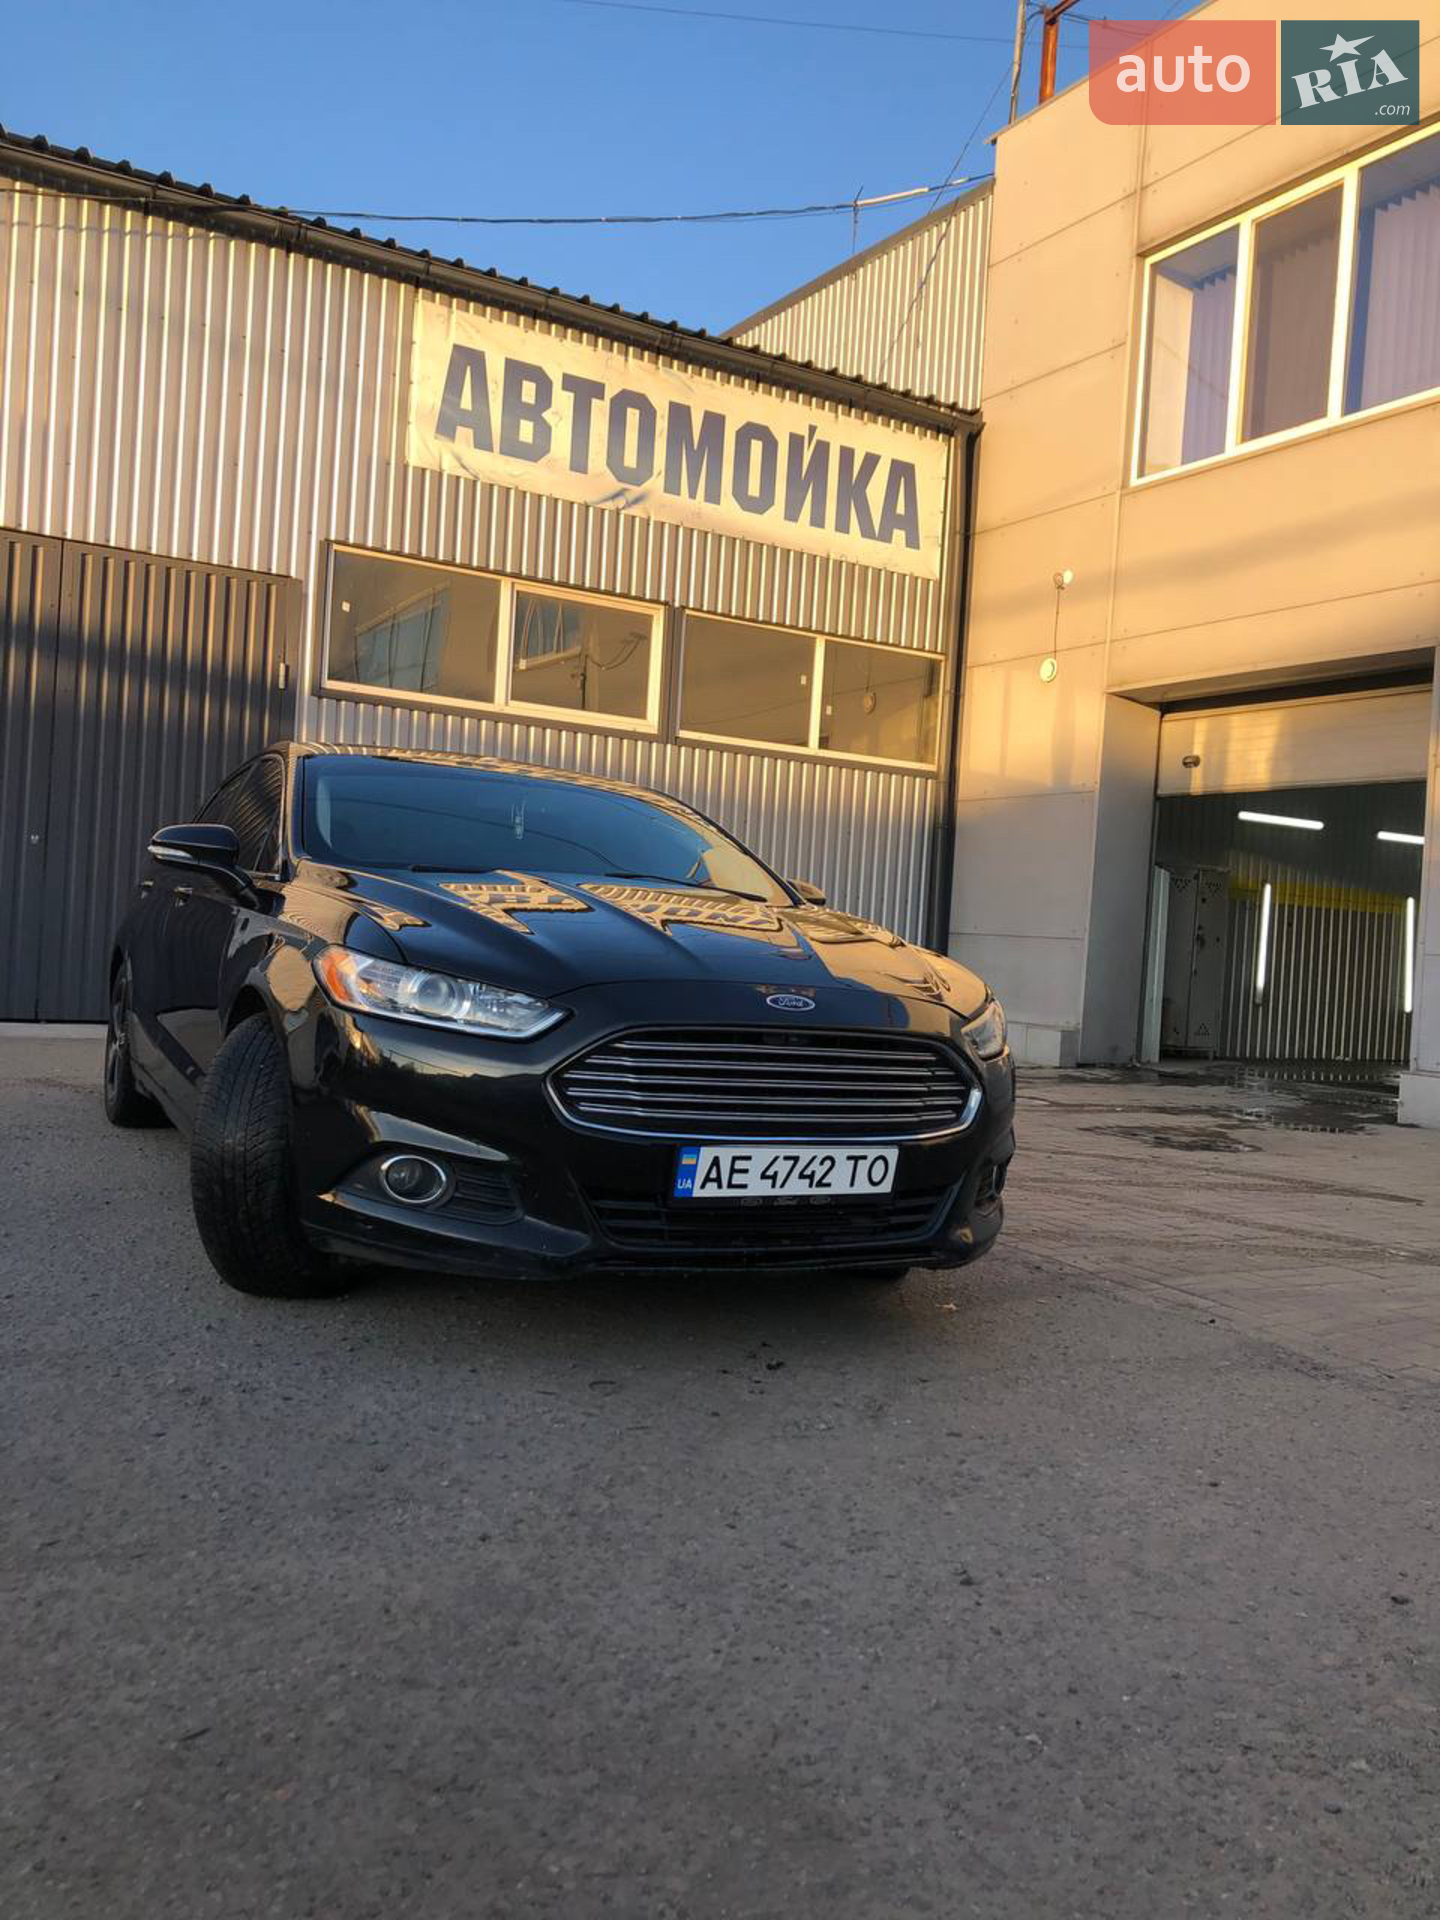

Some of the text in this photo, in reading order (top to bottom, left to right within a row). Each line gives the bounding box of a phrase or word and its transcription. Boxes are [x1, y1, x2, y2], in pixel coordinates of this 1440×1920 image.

[434, 342, 921, 550] АВТОМОЙКА
[677, 1178, 693, 1189] UA
[700, 1154, 890, 1190] AE 4742 TO
